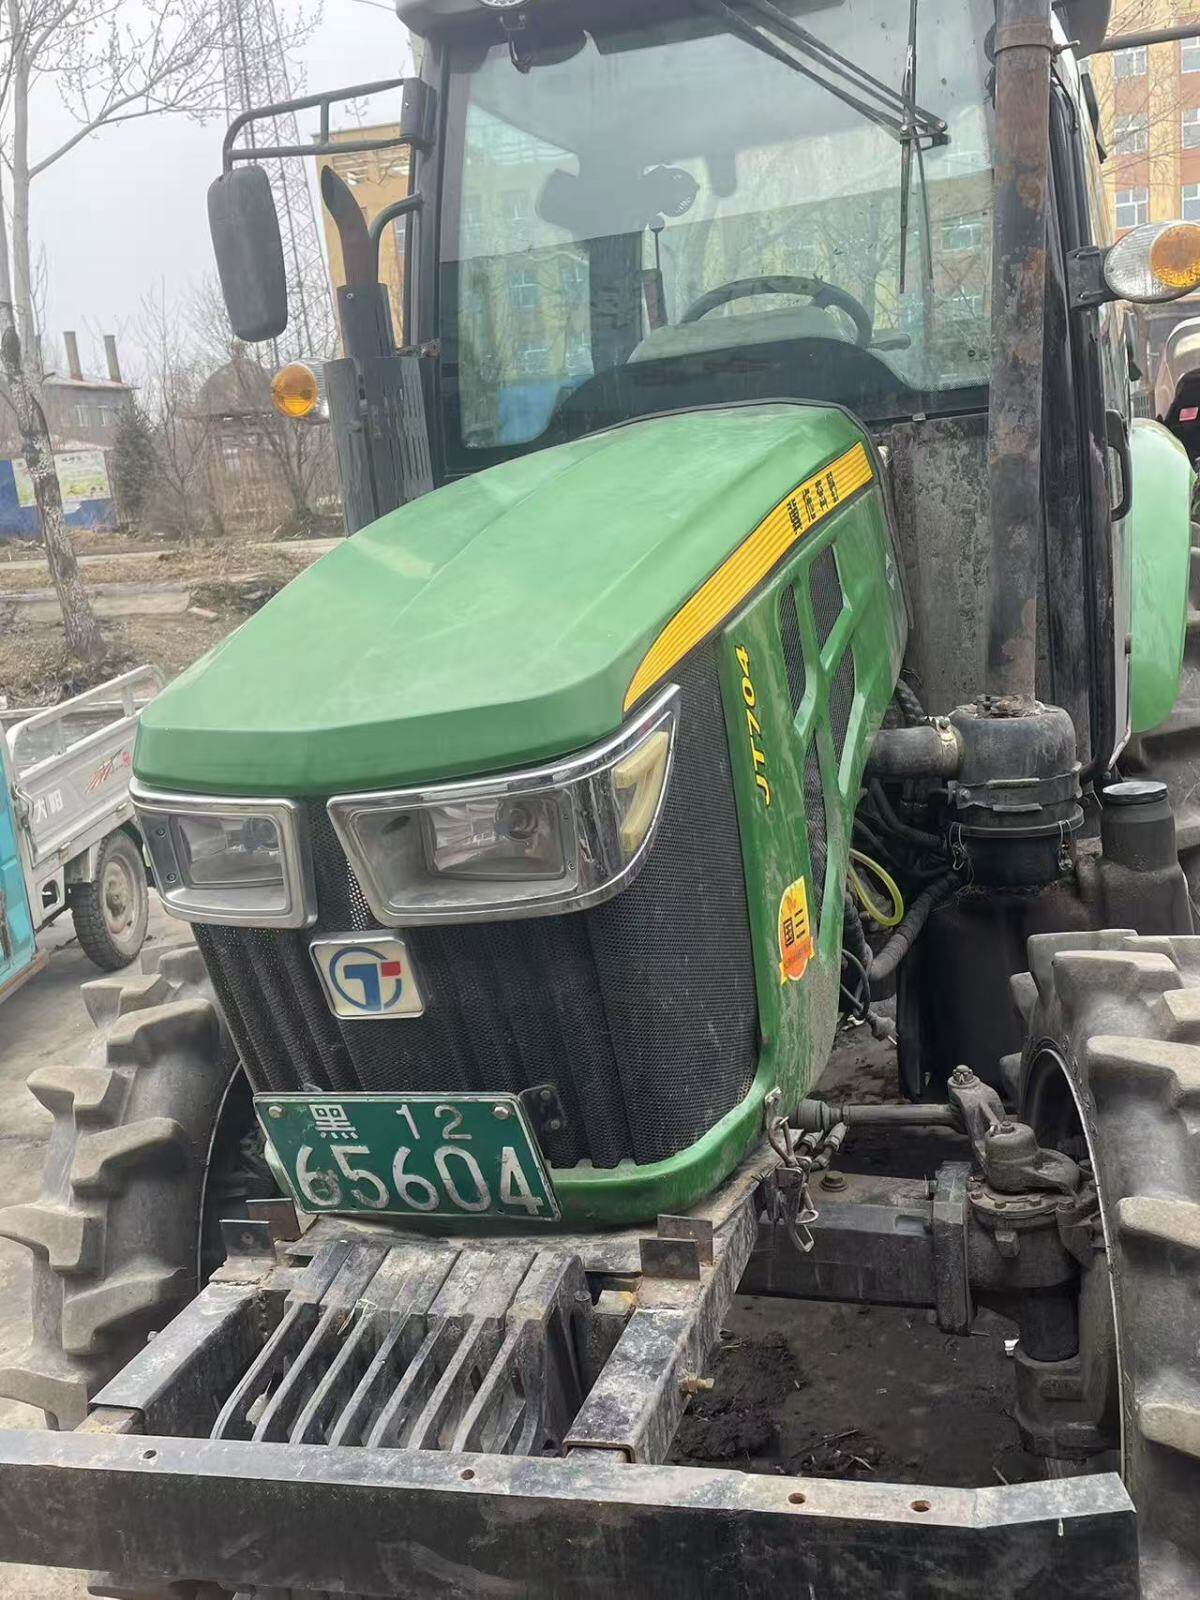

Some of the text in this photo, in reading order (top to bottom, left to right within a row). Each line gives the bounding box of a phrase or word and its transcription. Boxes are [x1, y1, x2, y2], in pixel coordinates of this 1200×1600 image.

[734, 644, 771, 808] JT704
[308, 1103, 473, 1141] 黑 12
[295, 1145, 545, 1216] 65604
